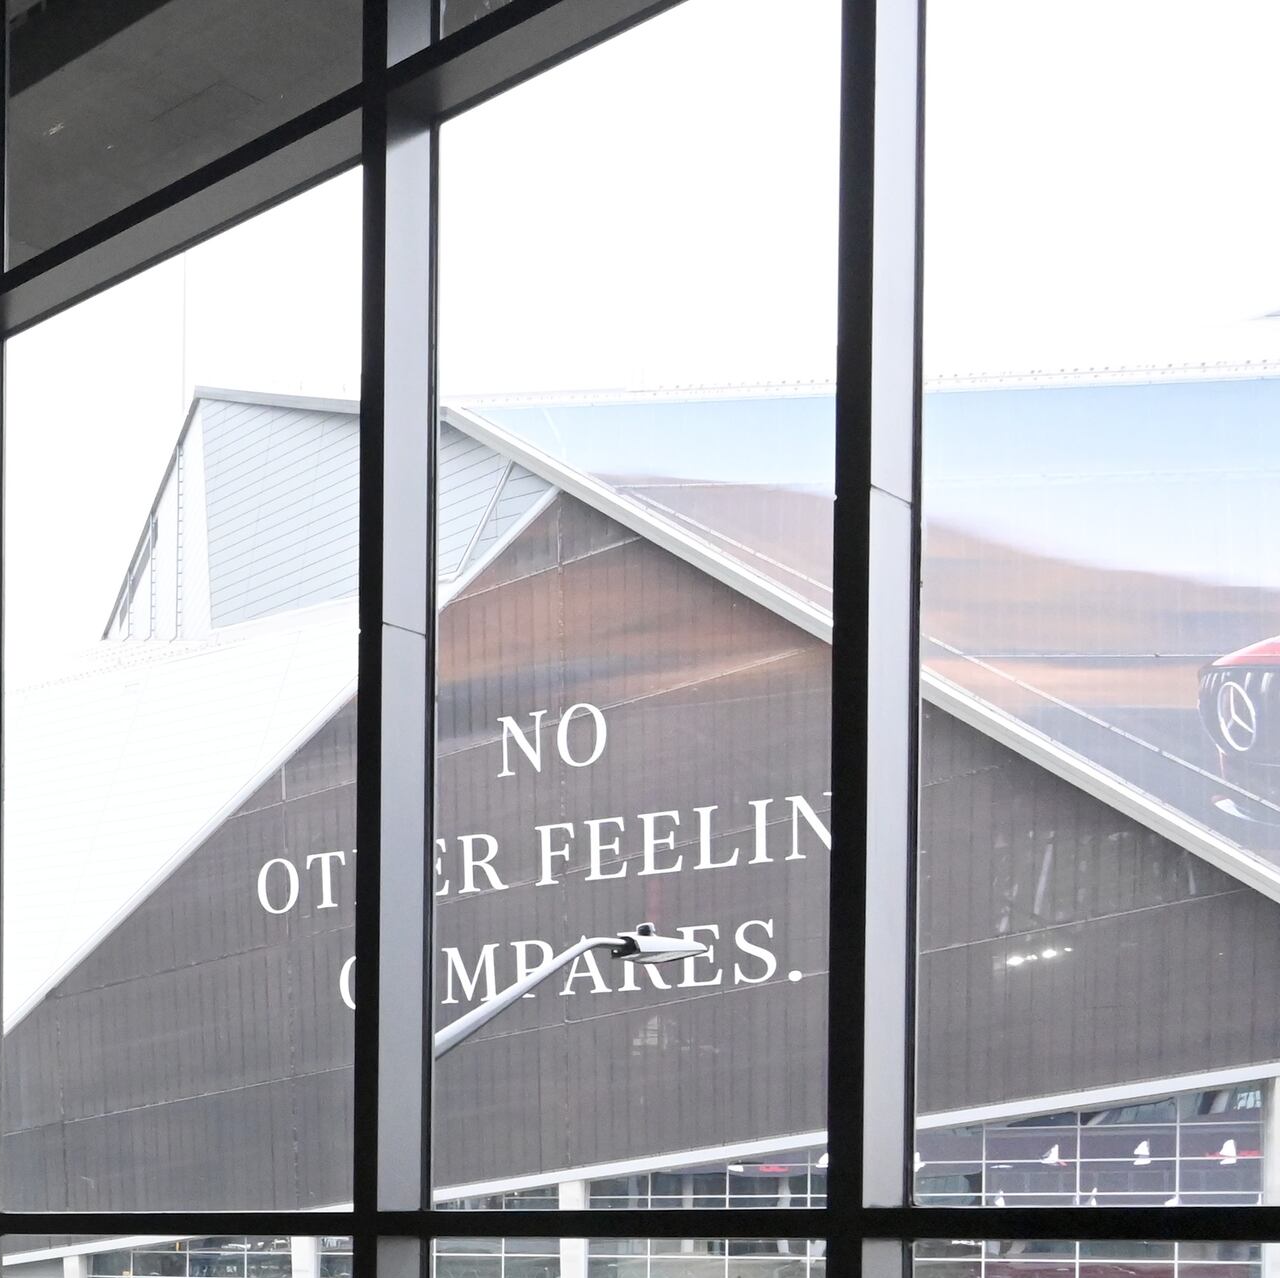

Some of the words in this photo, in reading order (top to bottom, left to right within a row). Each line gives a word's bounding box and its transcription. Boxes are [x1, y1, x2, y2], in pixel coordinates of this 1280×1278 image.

[496, 702, 608, 778] NO
[256, 833, 510, 915] OTR
[534, 791, 833, 887] FEELIN
